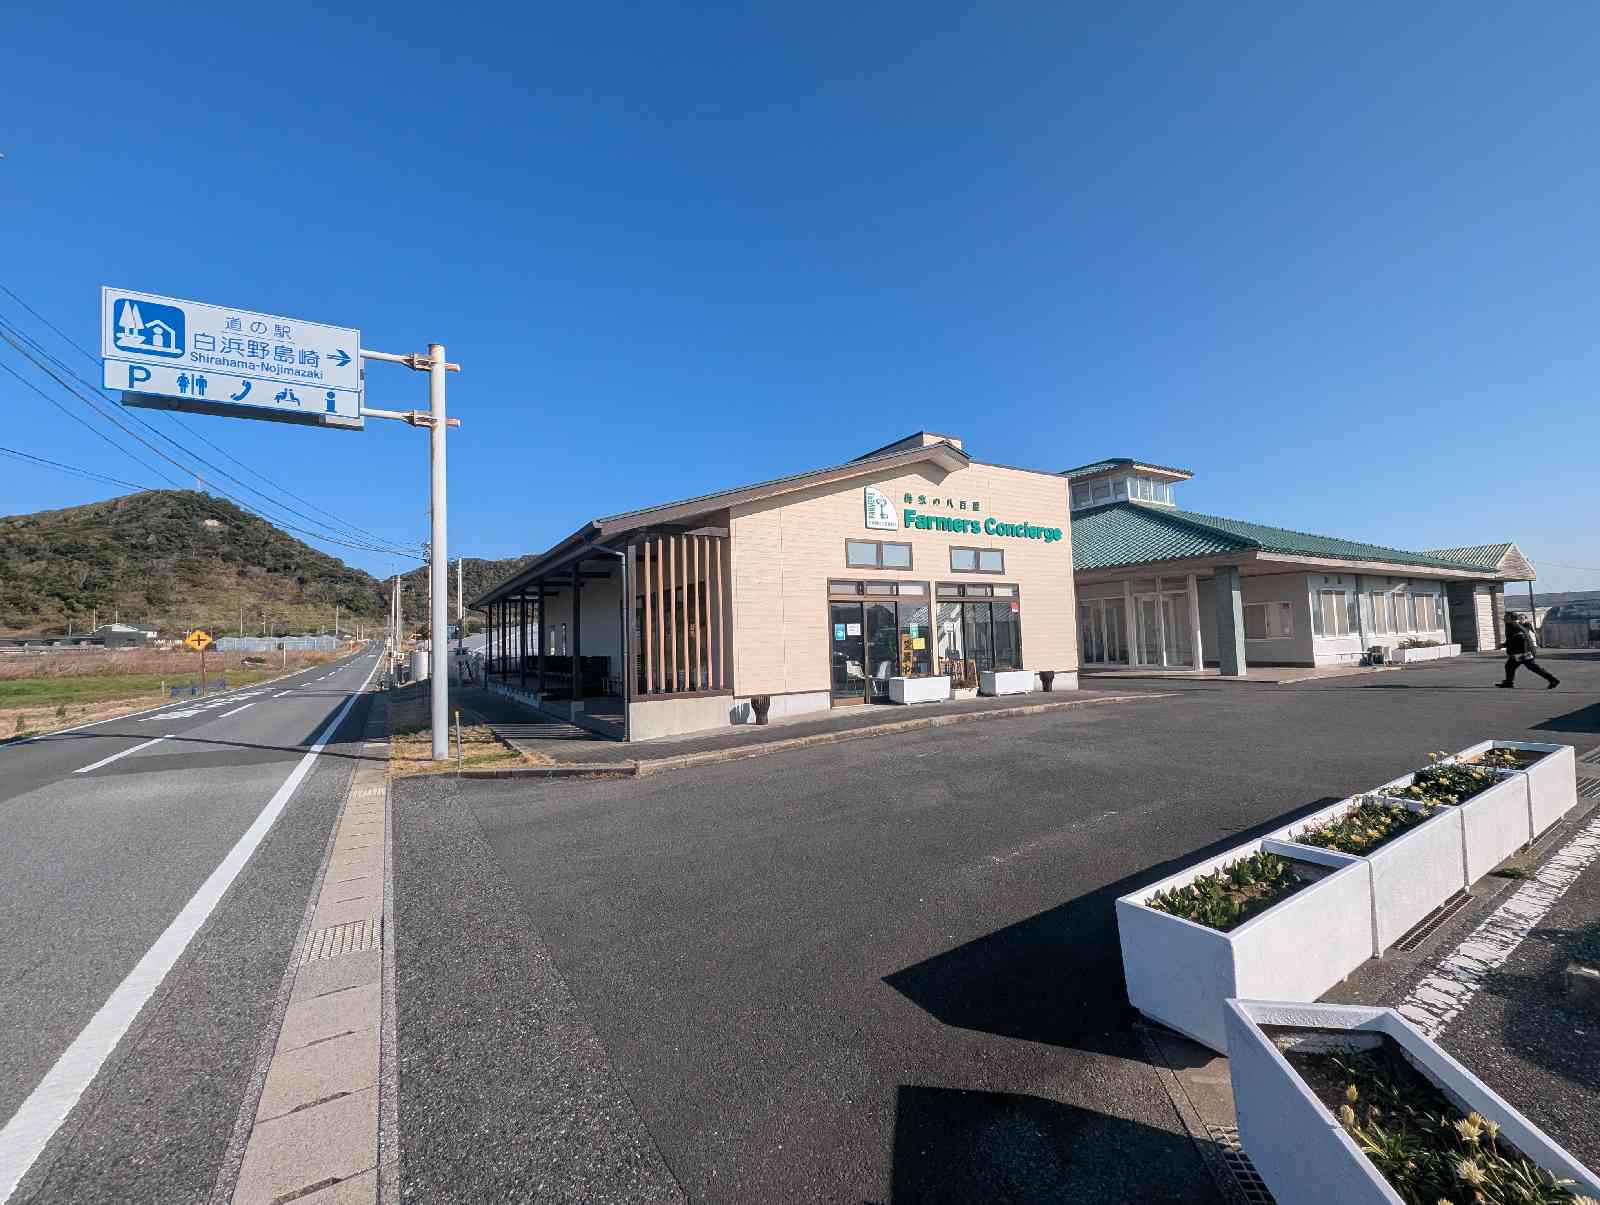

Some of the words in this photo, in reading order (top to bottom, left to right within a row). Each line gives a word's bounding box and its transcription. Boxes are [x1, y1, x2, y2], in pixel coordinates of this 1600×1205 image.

[225, 316, 292, 340] 道の駅
[194, 332, 321, 368] 白浜野島崎
[127, 365, 152, 388] P
[190, 351, 324, 380] Shirahama-Nojimazaki
[903, 508, 981, 535] Farmers
[984, 516, 1063, 543] Concierge
